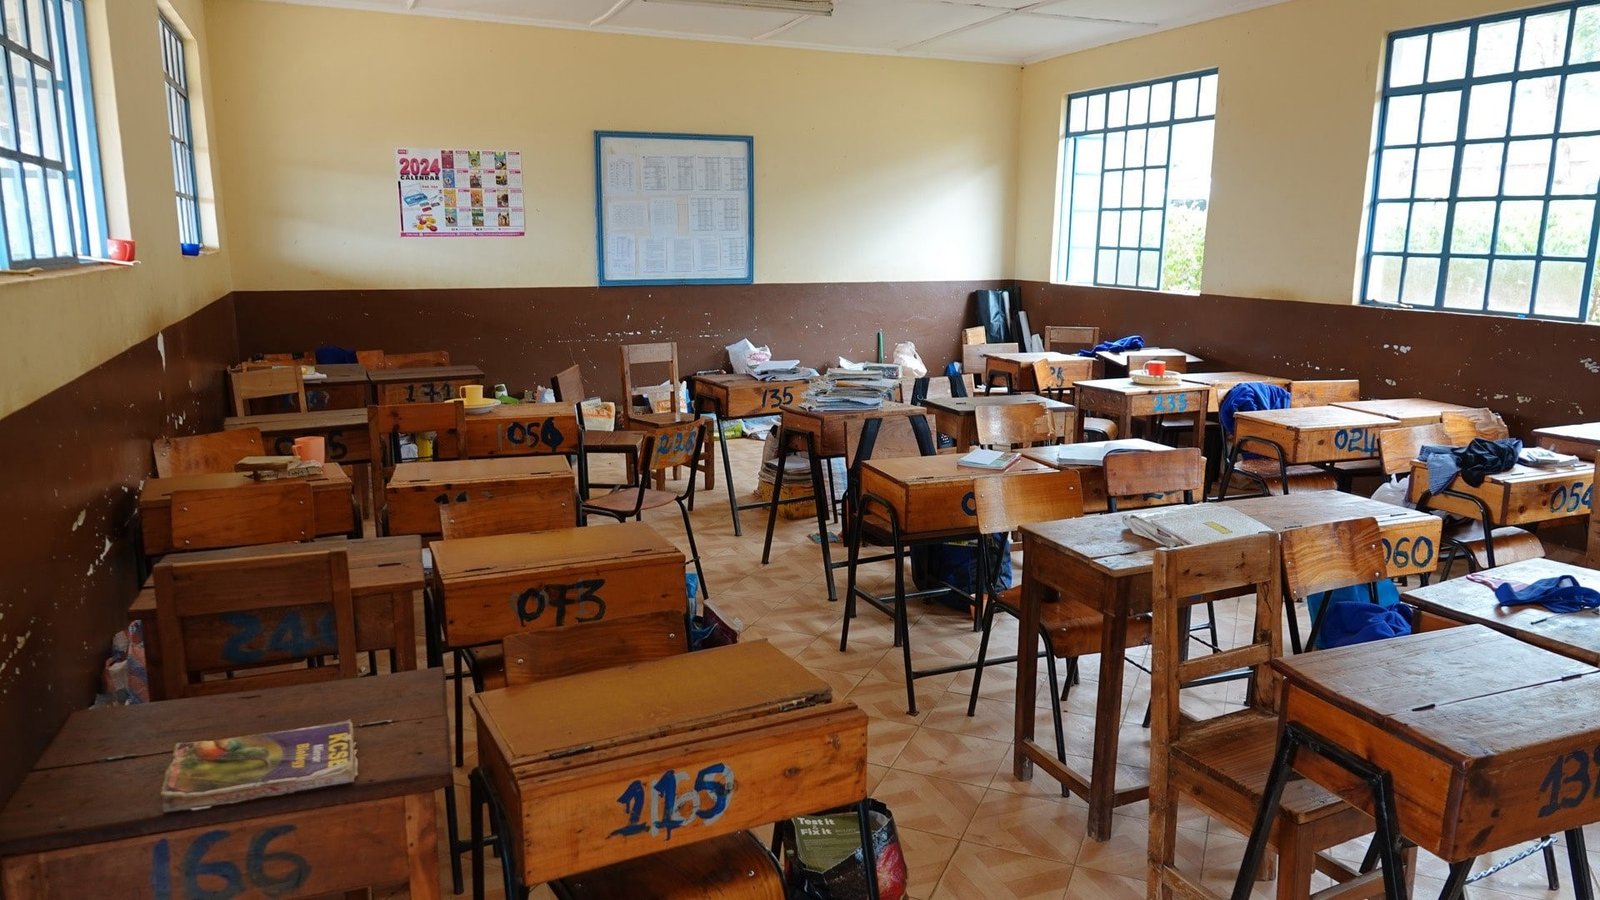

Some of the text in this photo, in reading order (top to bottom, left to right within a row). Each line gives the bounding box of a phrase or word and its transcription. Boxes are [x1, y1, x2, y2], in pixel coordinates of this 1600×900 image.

[399, 158, 441, 176] 2024
[760, 386, 795, 408] 135
[1153, 392, 1188, 413] 235
[516, 579, 607, 627] 073
[1537, 743, 1600, 818] 13
[798, 817, 824, 825] Test
[151, 825, 312, 900] 166
